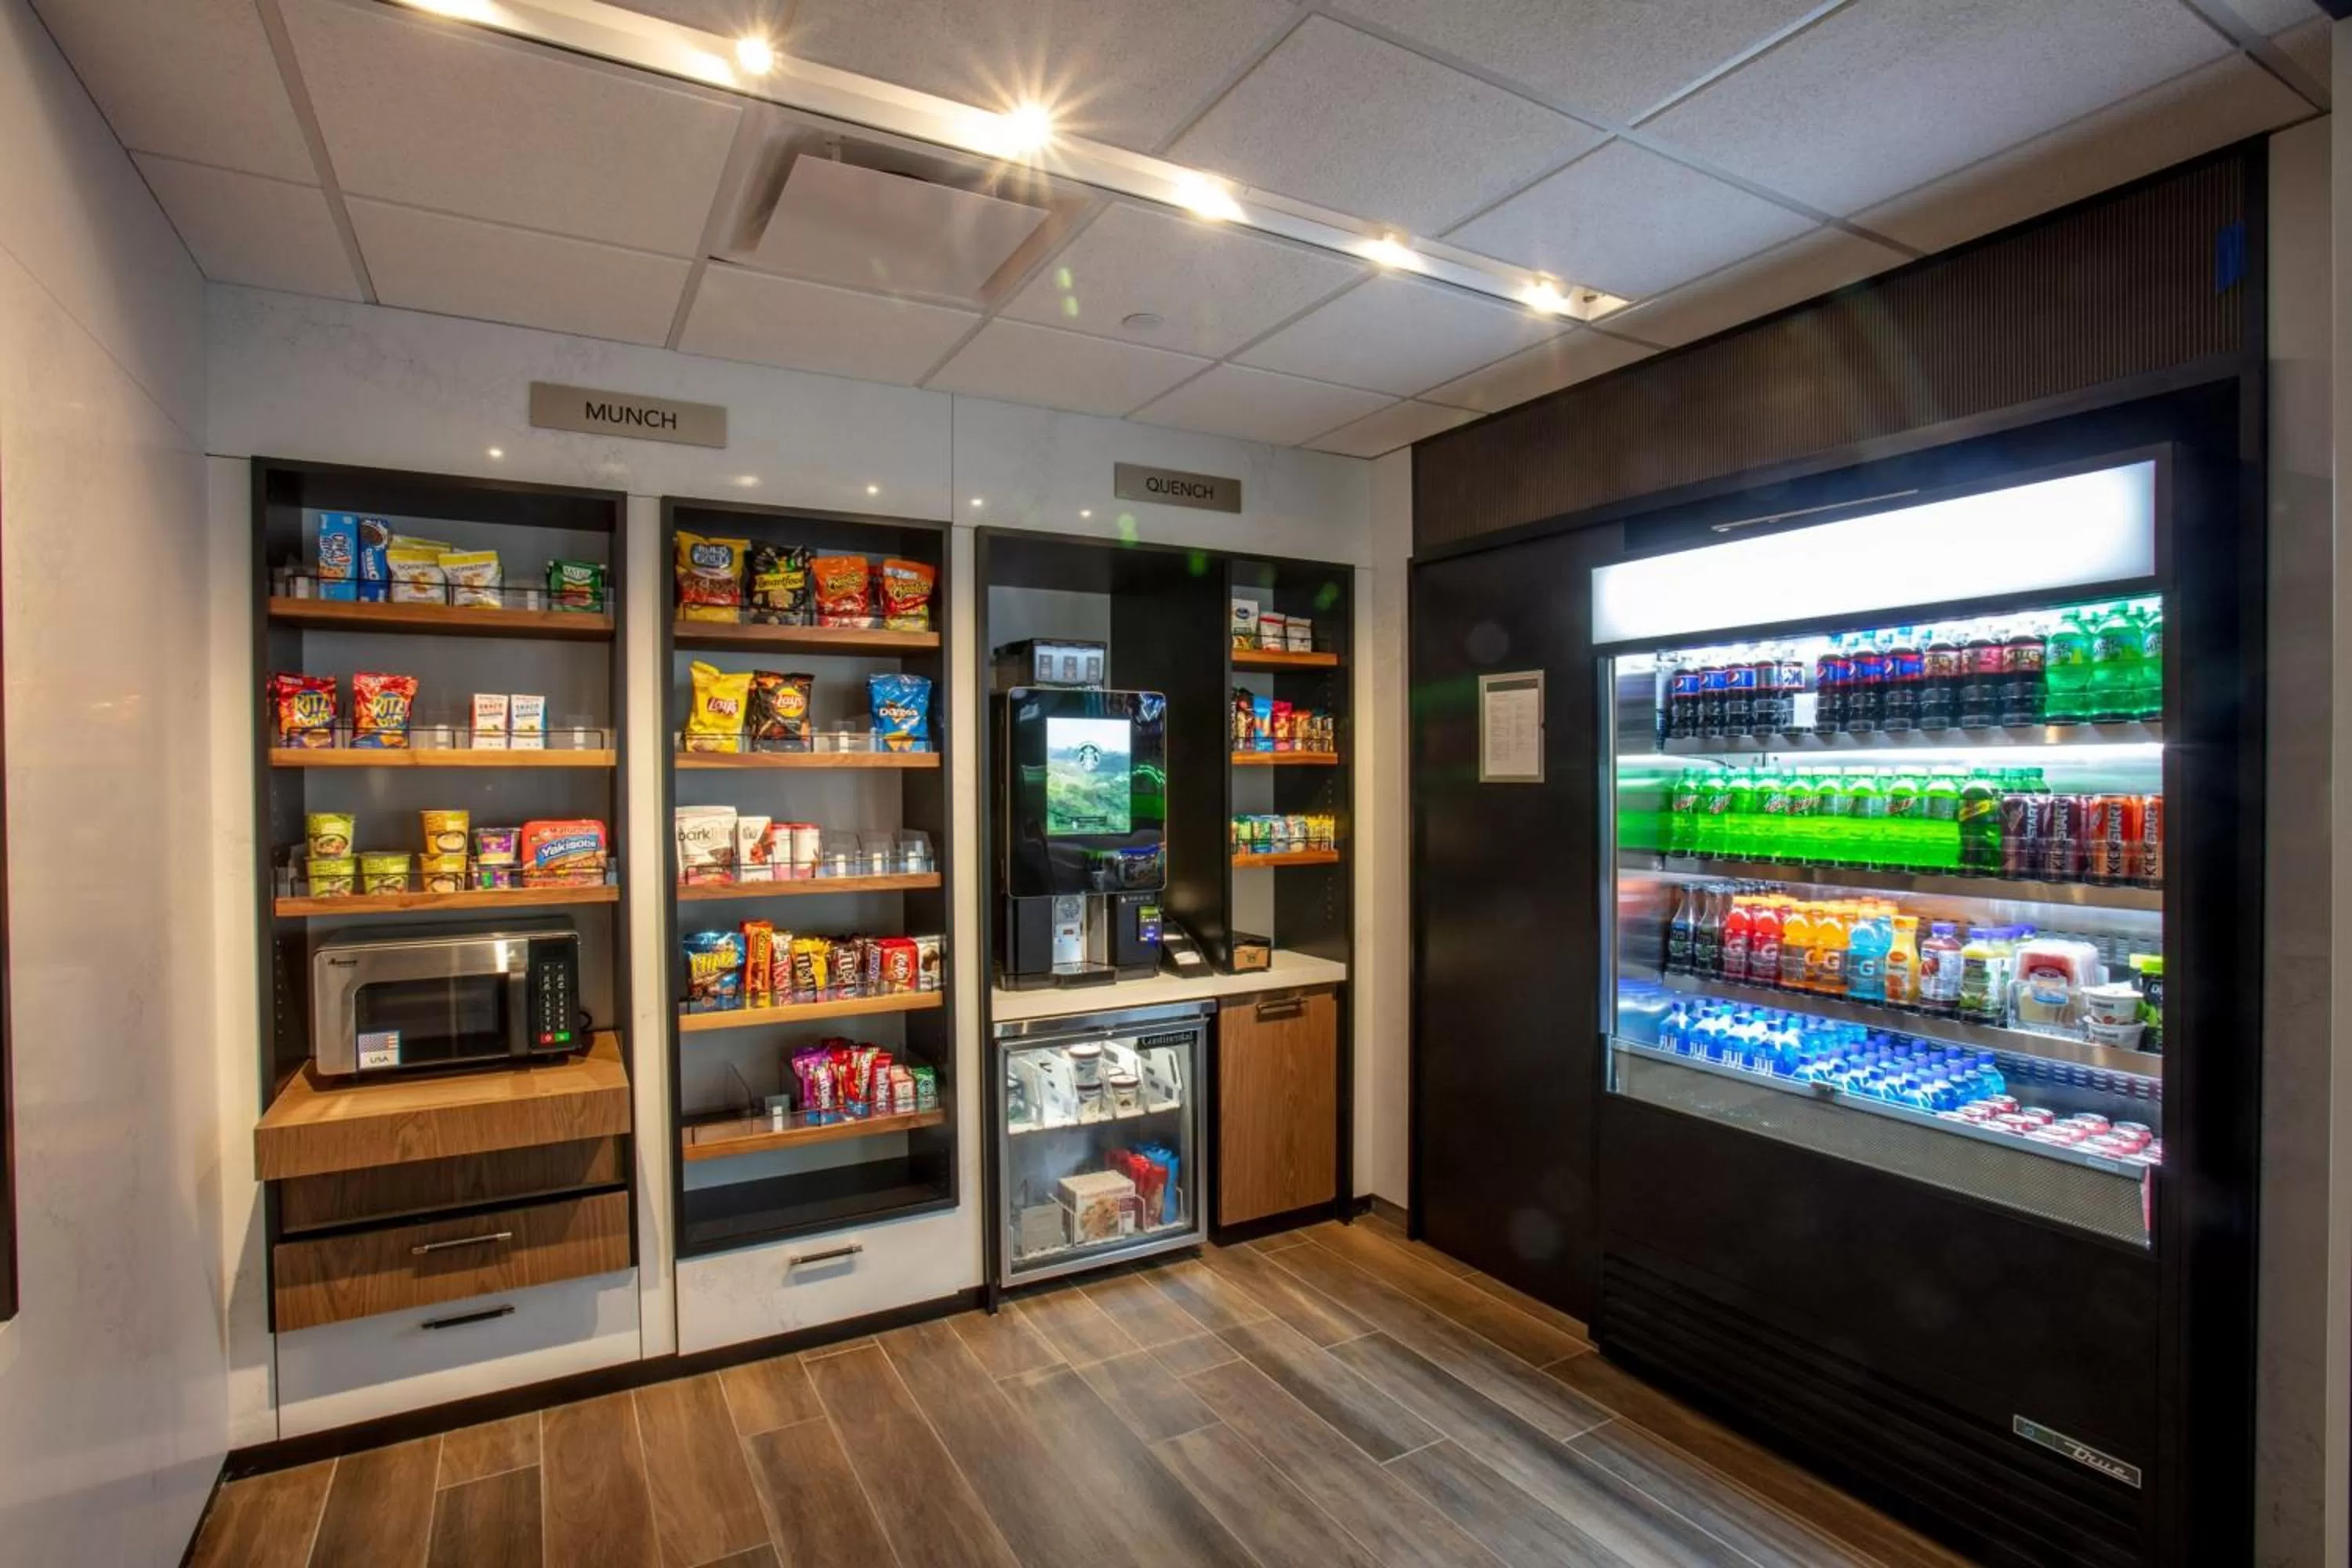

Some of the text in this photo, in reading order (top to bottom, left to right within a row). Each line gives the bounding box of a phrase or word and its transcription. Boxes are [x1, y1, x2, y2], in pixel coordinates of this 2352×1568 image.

[585, 401, 677, 430] MUNCH
[1145, 475, 1215, 500] QUENCH
[1859, 960, 1875, 976] G
[369, 1054, 390, 1064] USA
